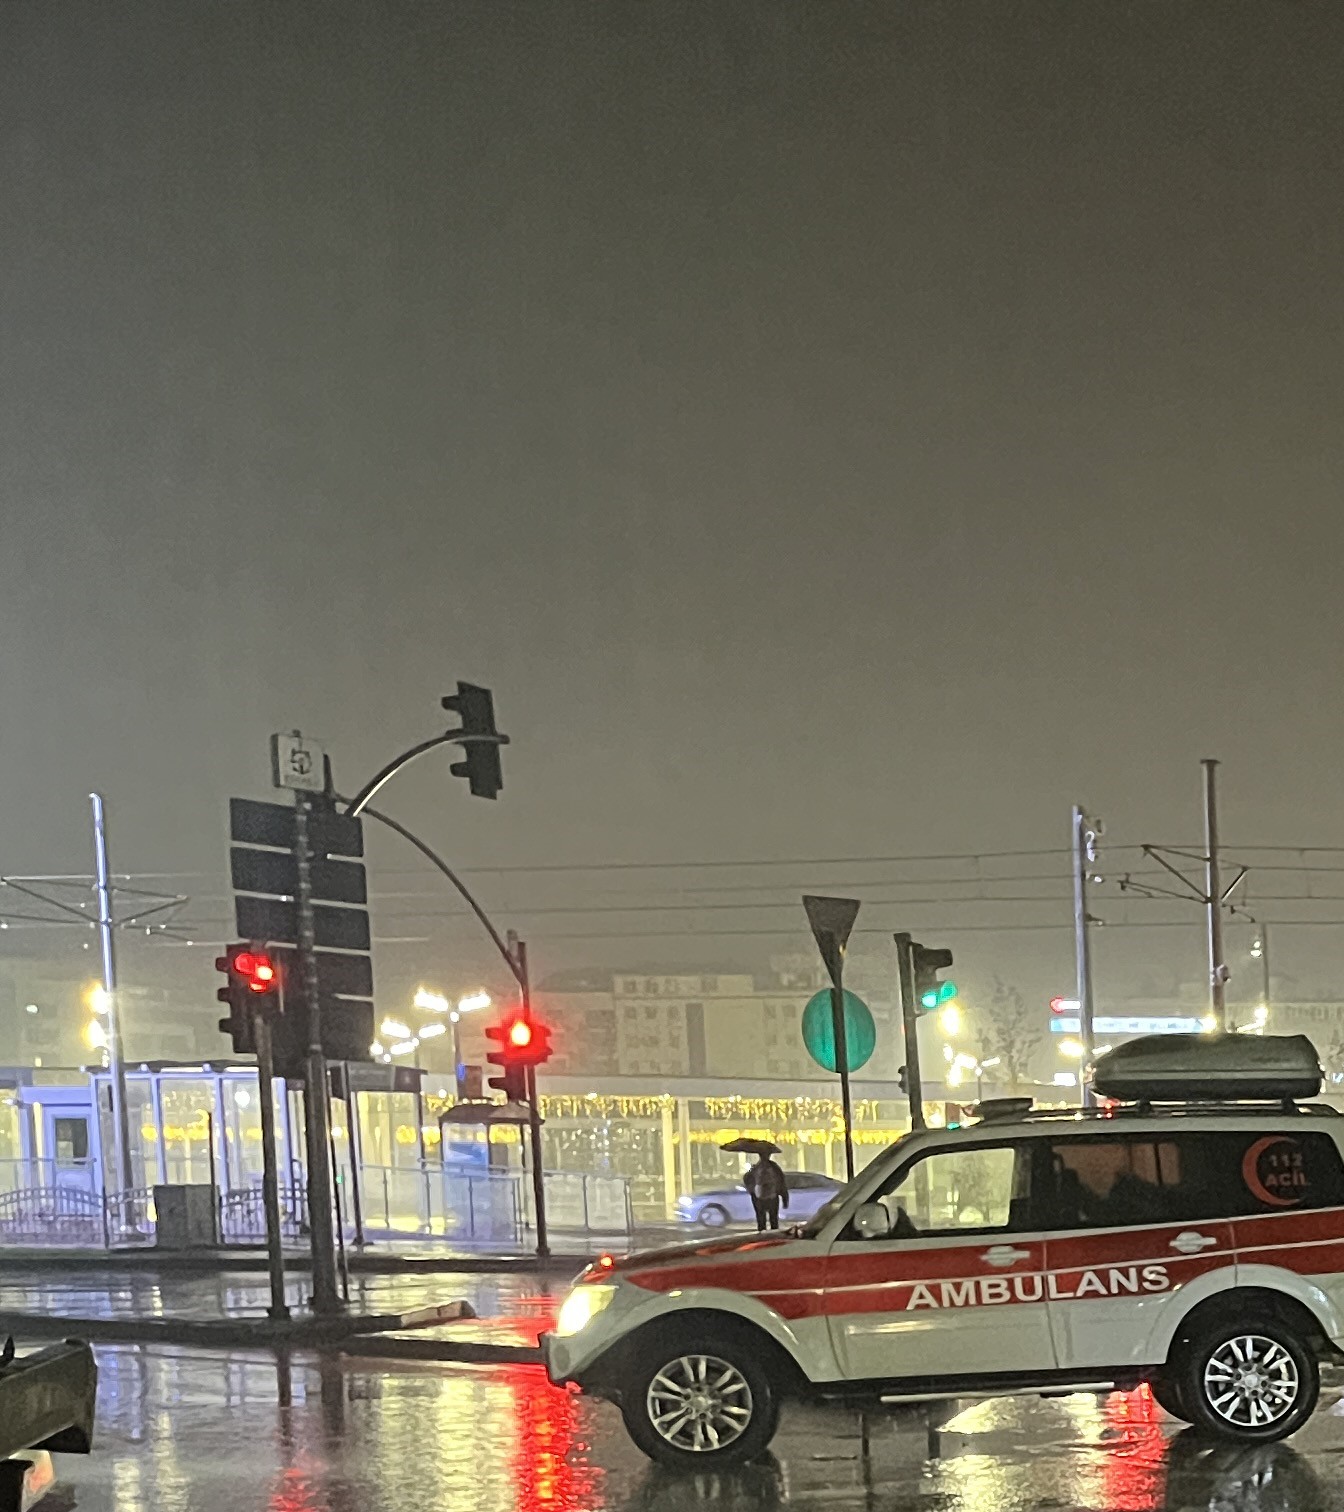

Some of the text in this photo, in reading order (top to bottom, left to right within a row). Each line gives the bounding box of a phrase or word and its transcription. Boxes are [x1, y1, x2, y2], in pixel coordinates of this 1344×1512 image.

[1269, 1152, 1303, 1167] 112
[1265, 1168, 1307, 1187] ACİL
[905, 1264, 1171, 1311] AMBULANS
